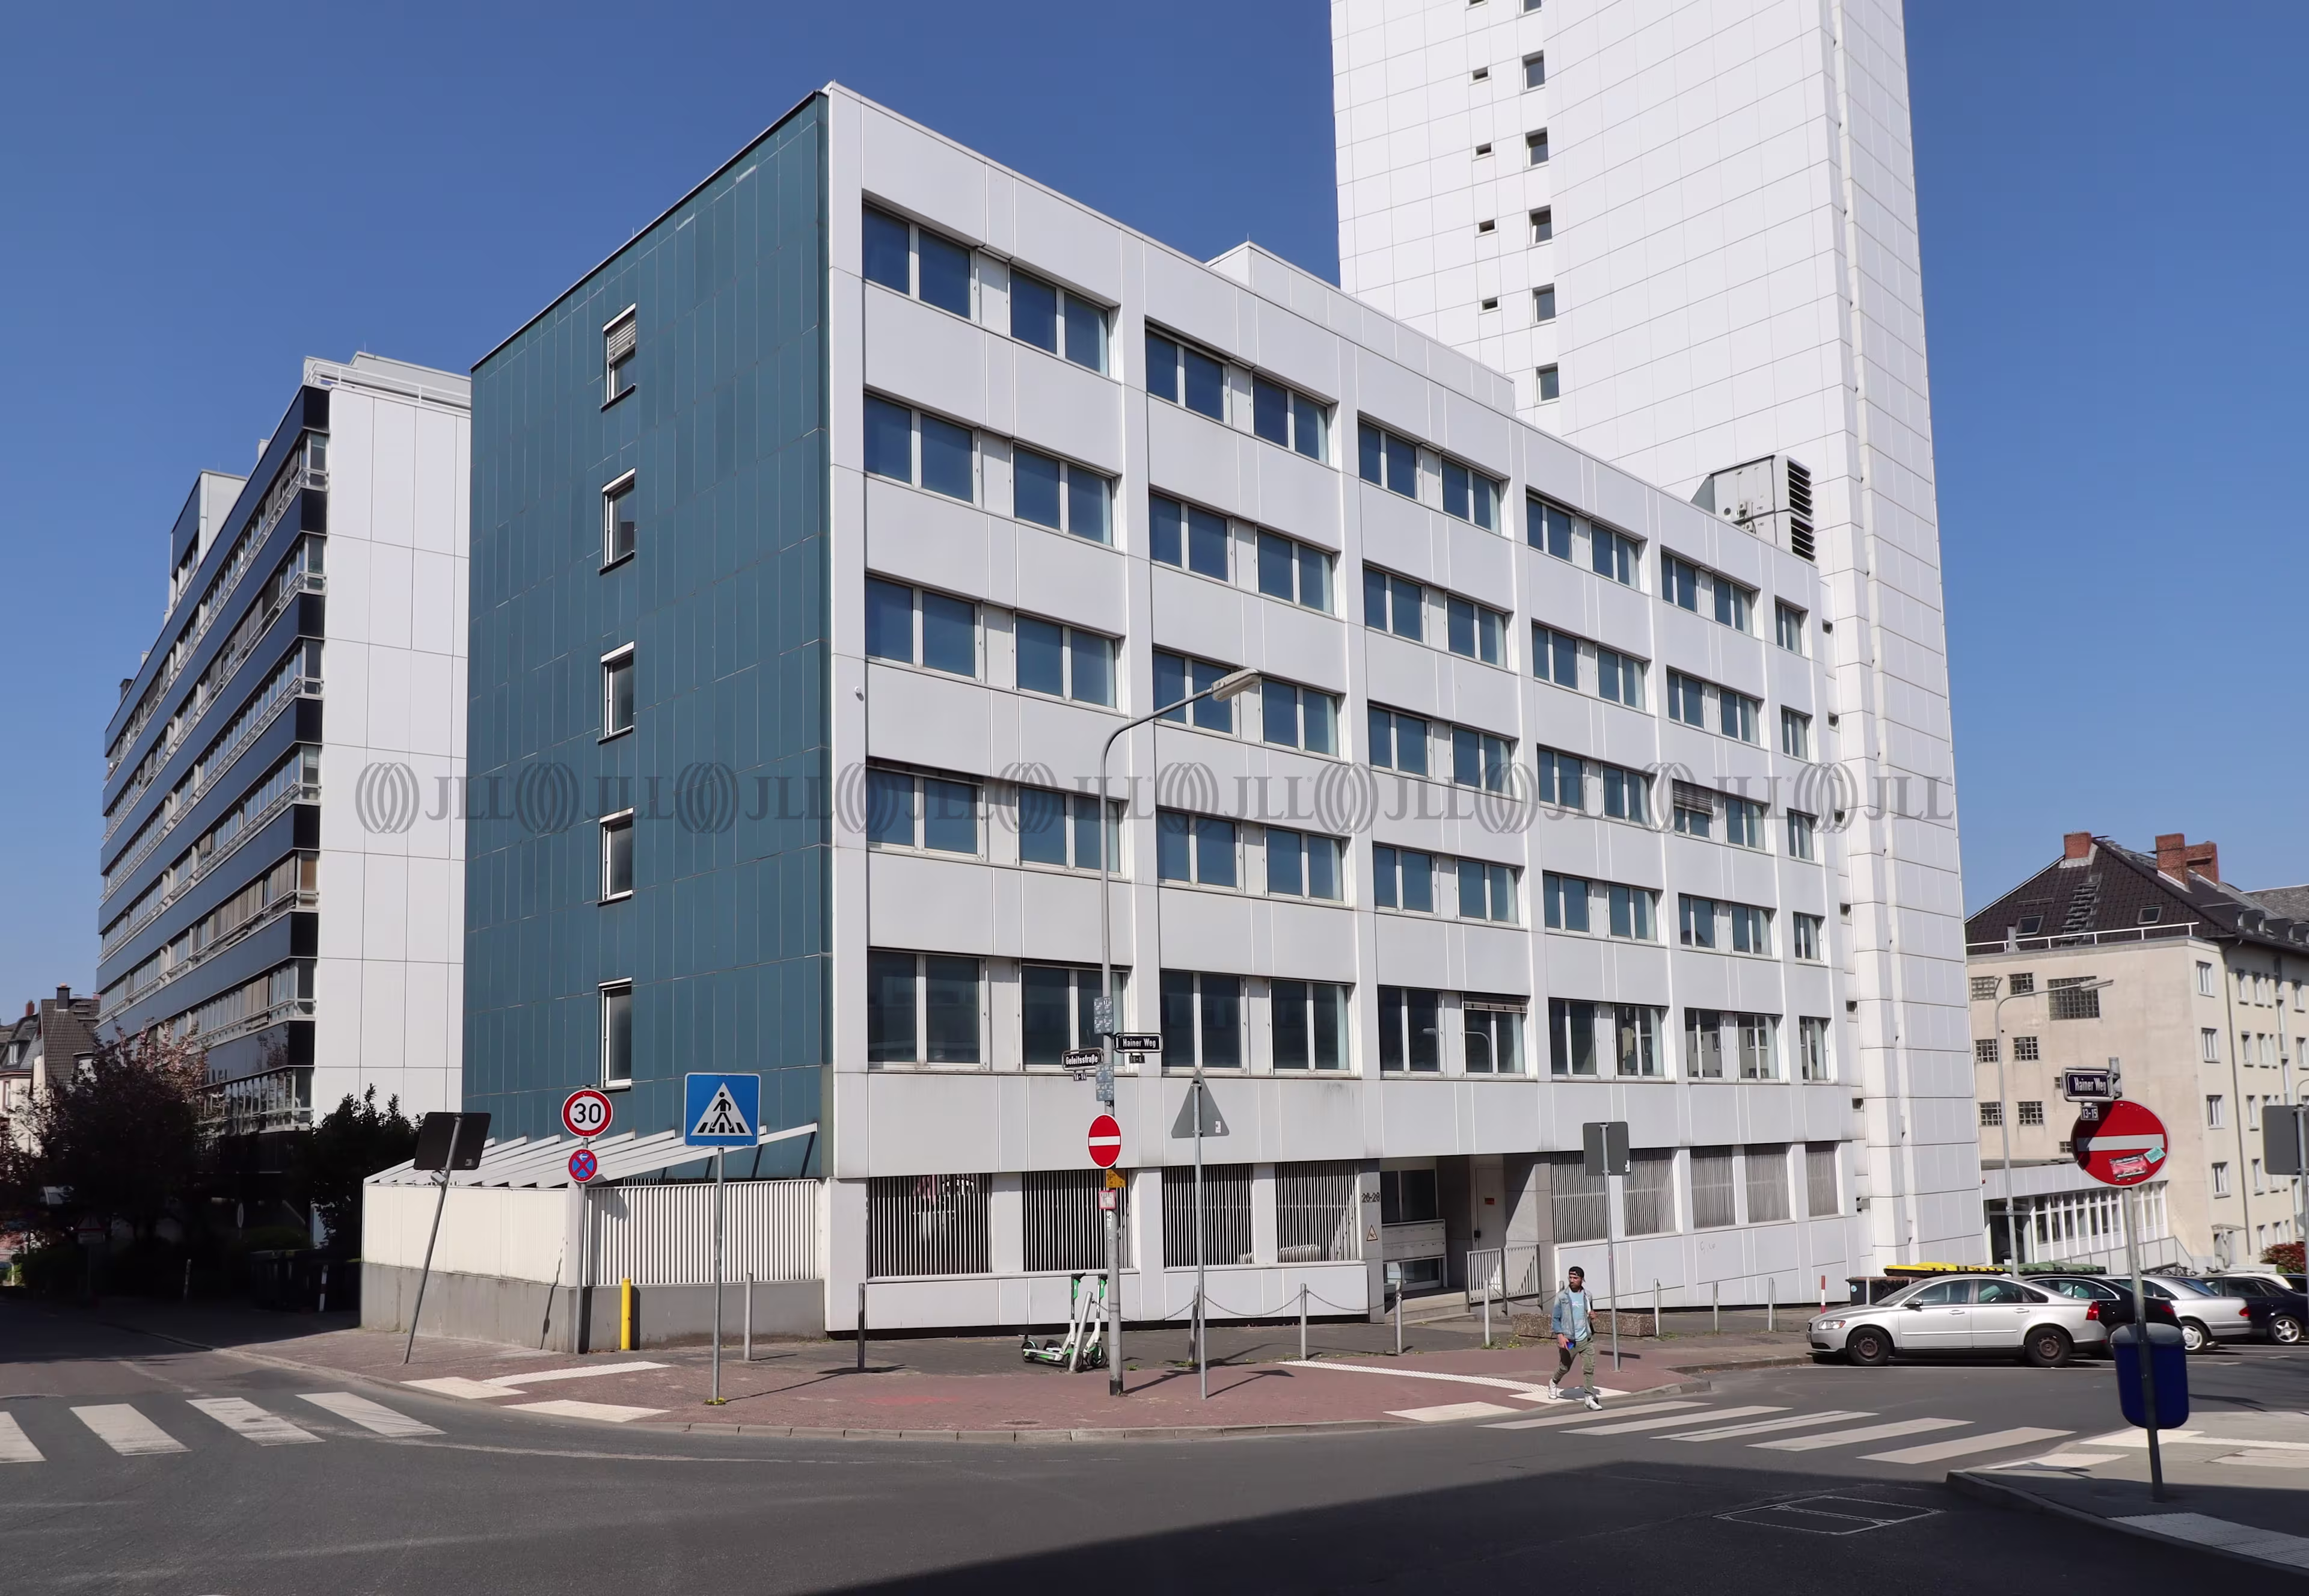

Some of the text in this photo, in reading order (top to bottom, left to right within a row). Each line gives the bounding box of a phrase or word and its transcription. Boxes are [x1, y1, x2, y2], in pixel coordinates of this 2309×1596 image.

[1123, 1038, 1156, 1048] Hainer Weg
[1066, 1054, 1098, 1065] Geleitsstraße
[2073, 1077, 2106, 1094] Hainer Weg
[574, 1103, 601, 1123] 30
[2082, 1108, 2097, 1119] 13-15
